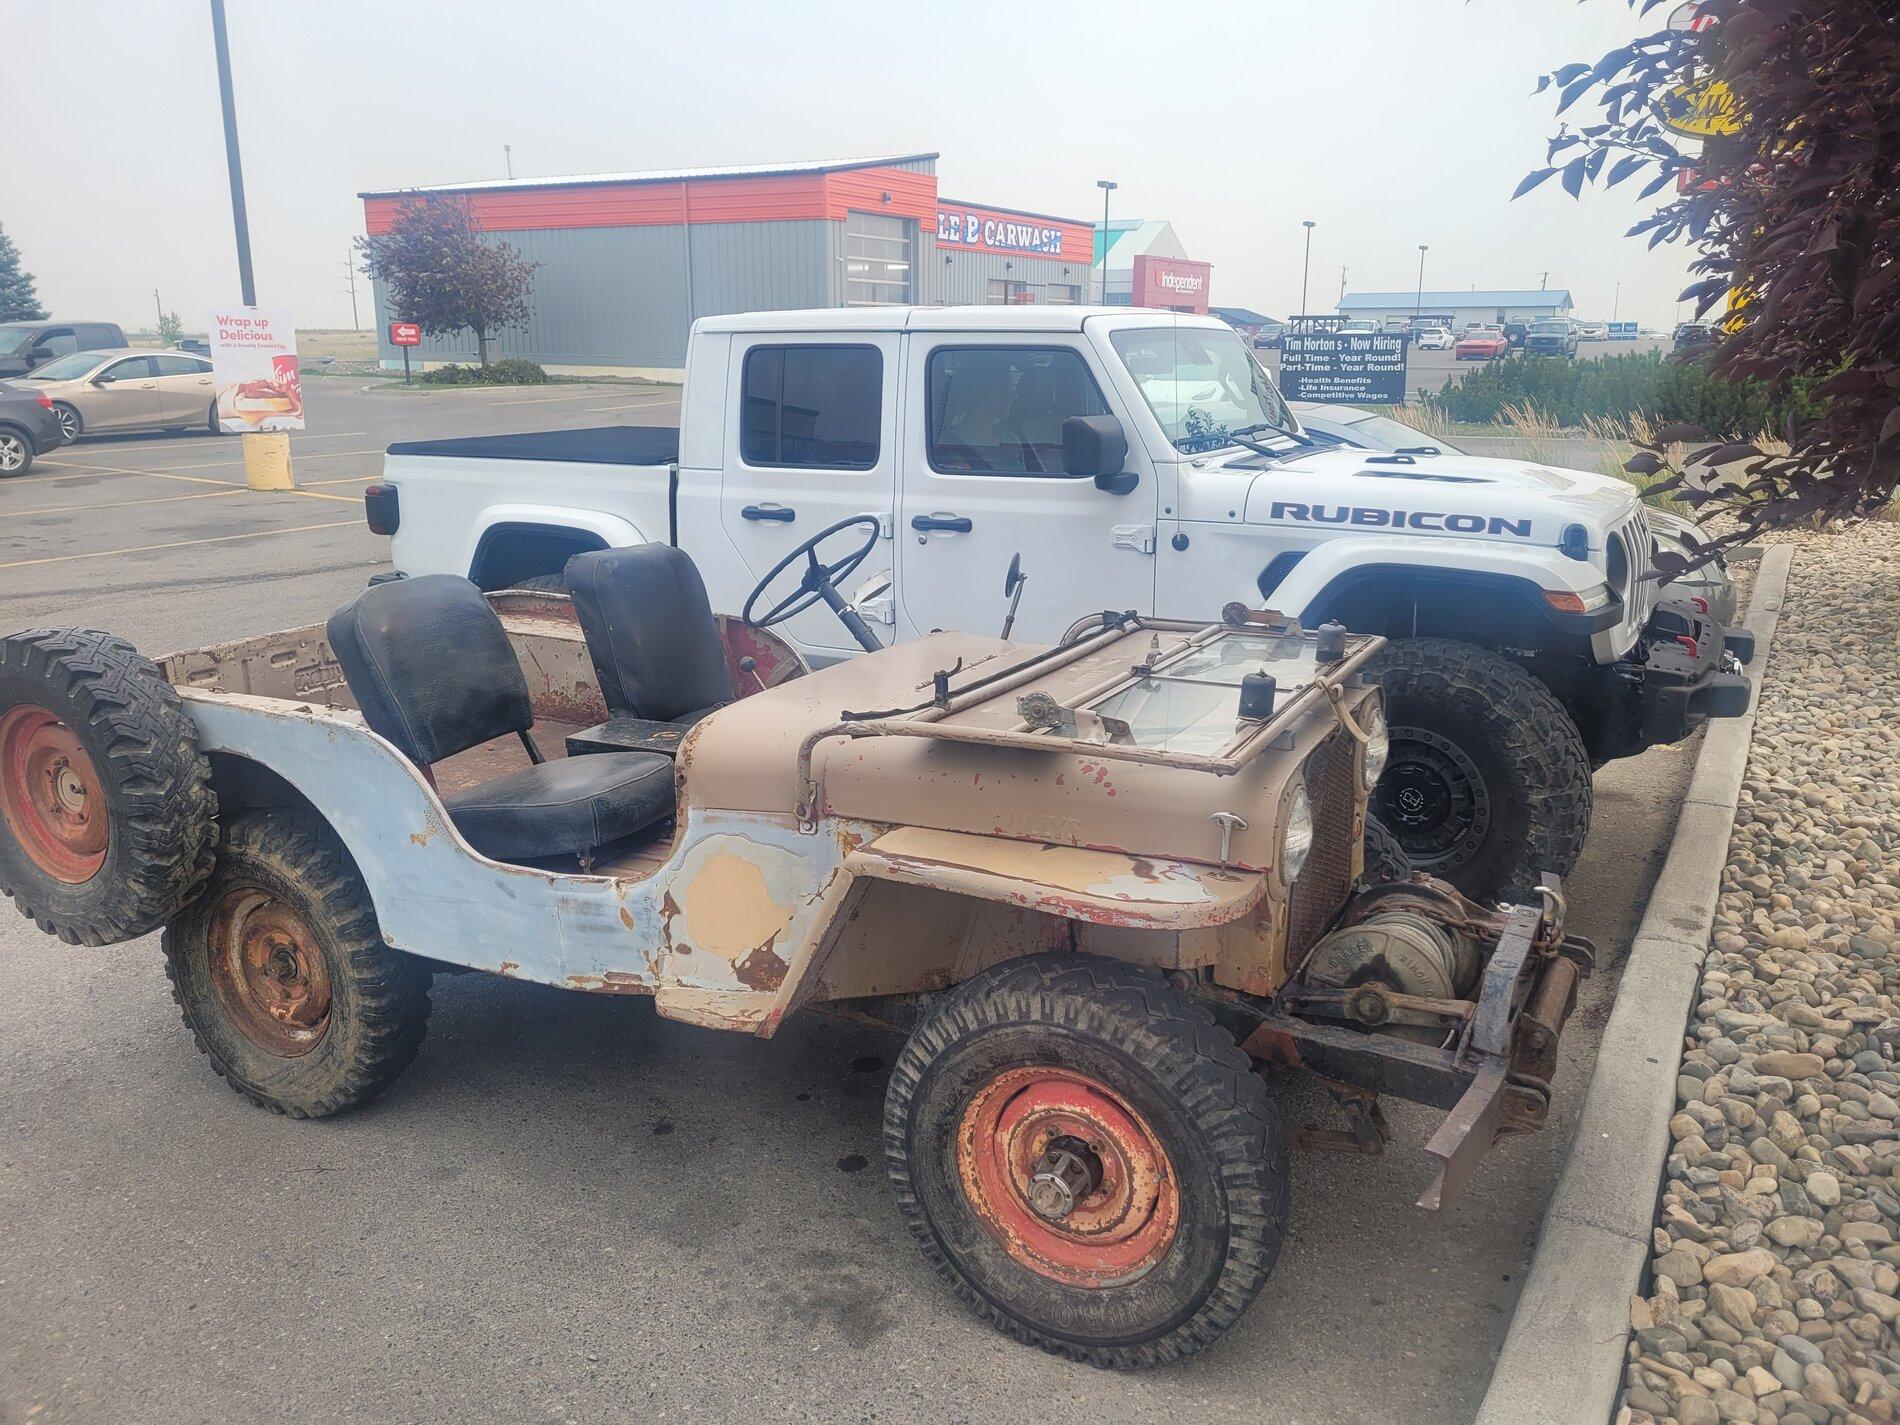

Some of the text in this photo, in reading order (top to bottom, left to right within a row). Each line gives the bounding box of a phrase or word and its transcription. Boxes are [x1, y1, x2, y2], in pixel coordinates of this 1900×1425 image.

[965, 214, 980, 243] B
[983, 219, 1062, 254] CARWASH
[1161, 271, 1203, 293] Independent
[216, 315, 268, 330] Wrap up
[220, 330, 273, 341] Delicious
[1284, 336, 1301, 350] Tim
[1350, 336, 1371, 351] Now
[1373, 336, 1402, 353] Hiring
[1282, 353, 1301, 361] Full
[1304, 353, 1330, 361] Time
[1338, 353, 1363, 361] Year
[1365, 353, 1401, 361] Round!
[1280, 363, 1331, 371] Part-Time
[1340, 363, 1365, 371] Year
[1367, 363, 1404, 371] Round!
[1357, 392, 1388, 400] Wages
[1270, 501, 1532, 537] RUBICON
